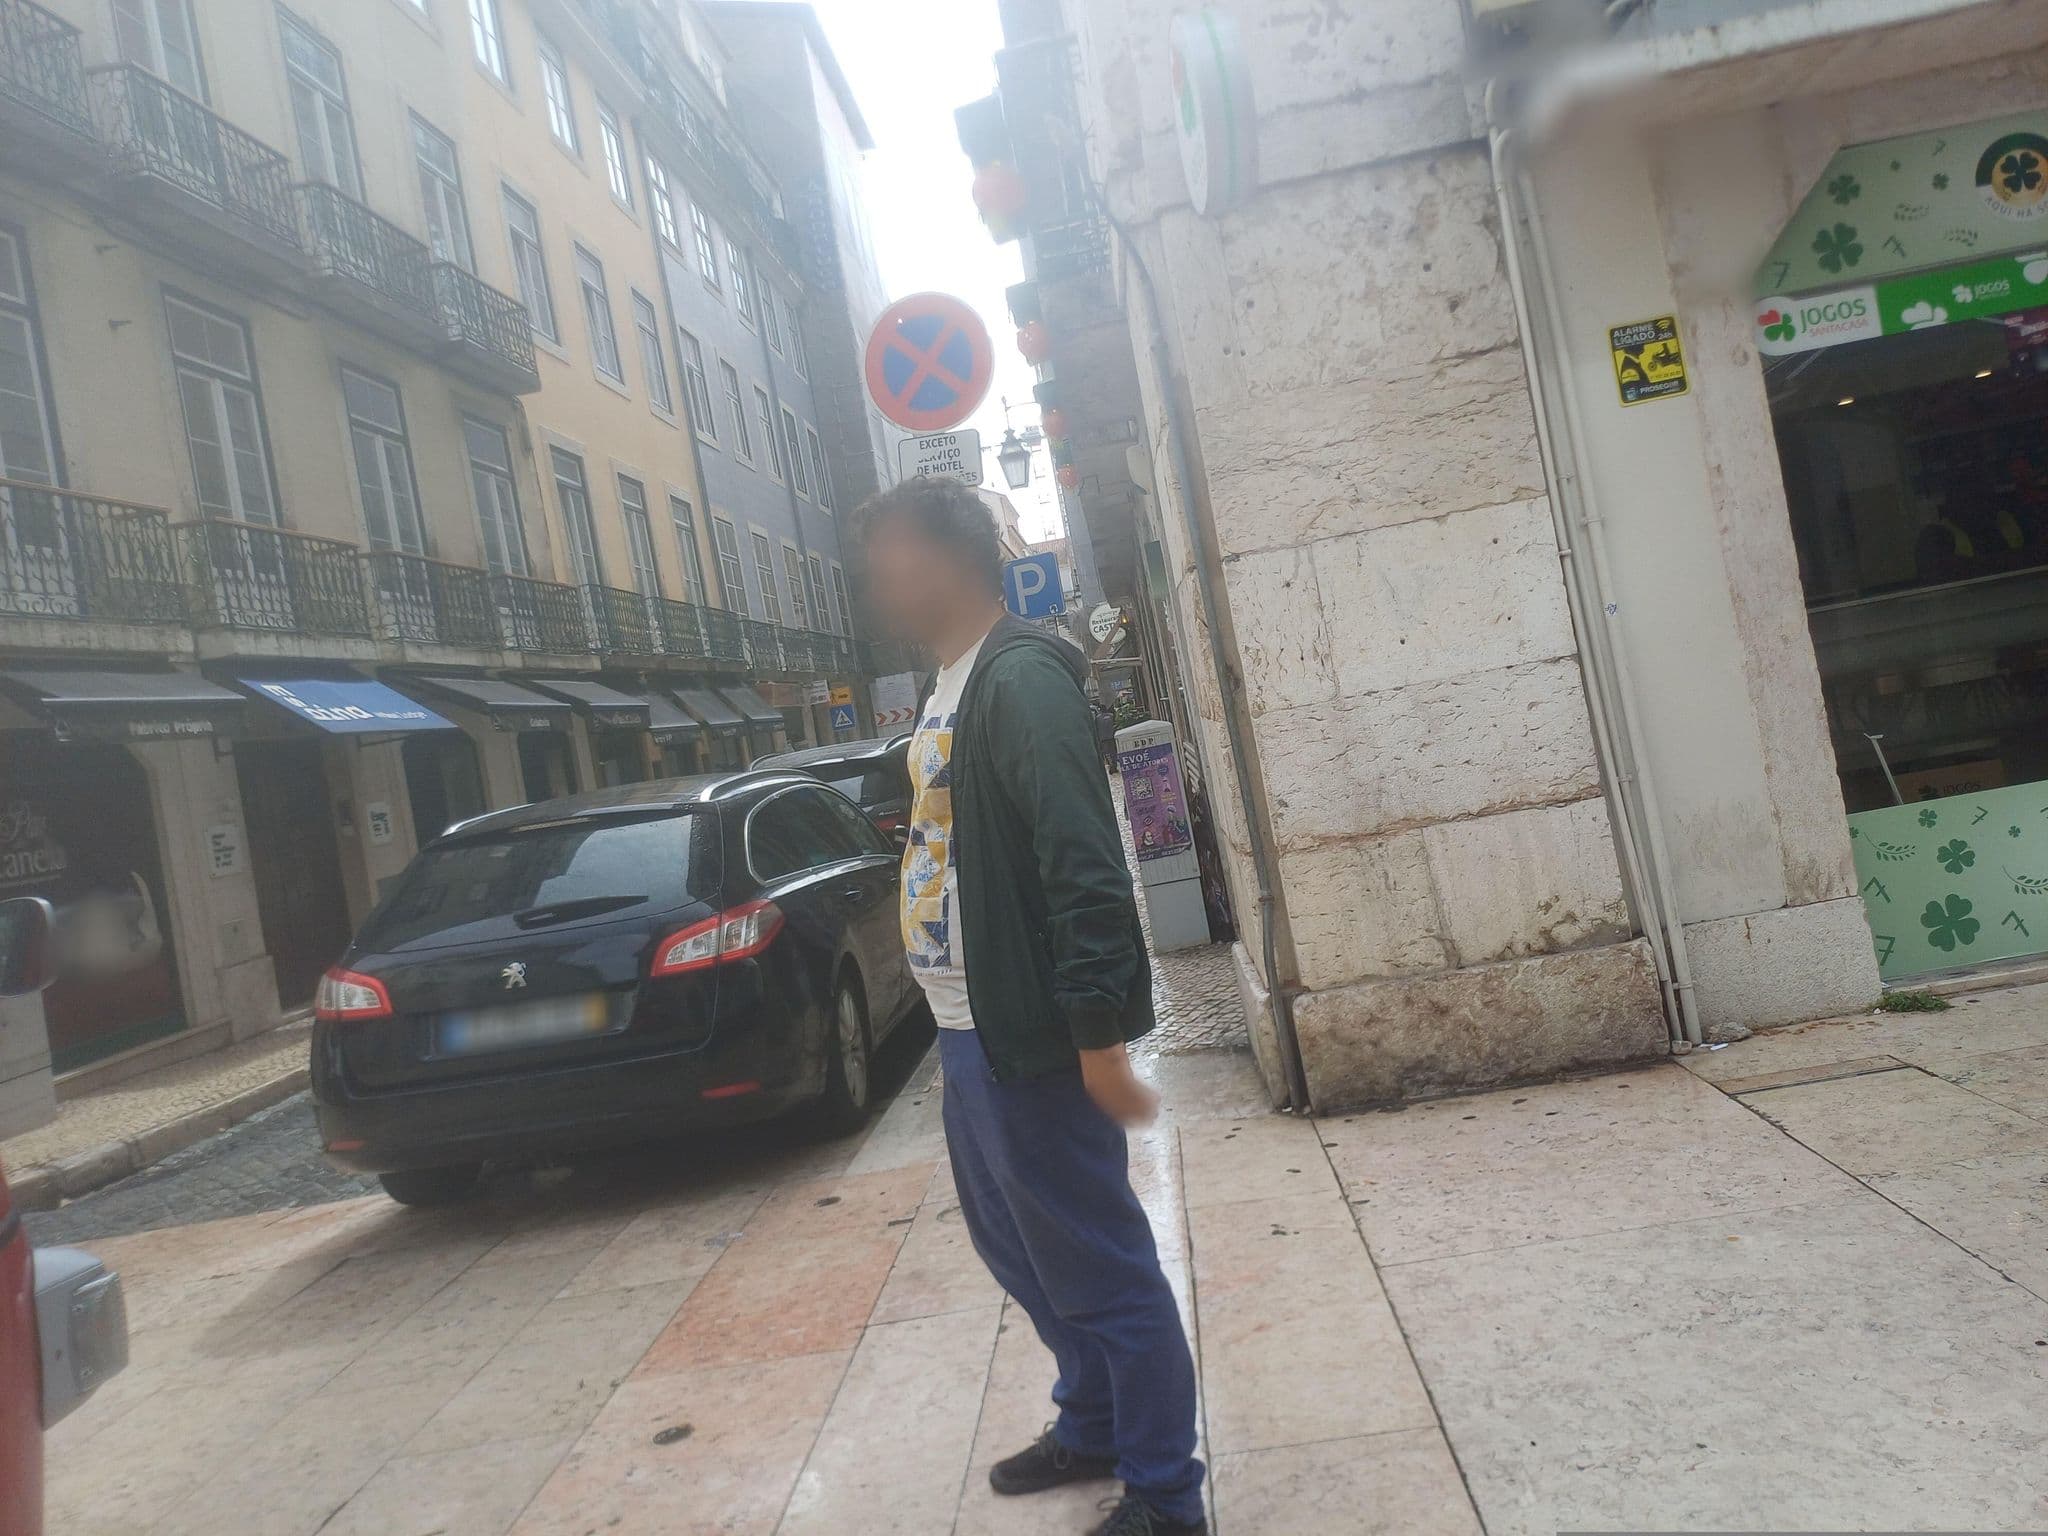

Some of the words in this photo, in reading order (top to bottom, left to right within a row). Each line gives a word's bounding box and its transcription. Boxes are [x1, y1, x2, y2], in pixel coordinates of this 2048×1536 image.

[1974, 279, 2010, 299] JOGOS
[1800, 298, 1867, 333] JOGOS
[1613, 324, 1654, 338] ALARME
[1809, 319, 1869, 337] SANTACASA
[1614, 330, 1656, 346] LIGADO
[919, 435, 957, 450] EXCETO
[916, 464, 930, 475] DE
[932, 460, 965, 473] HOTEL
[1012, 562, 1046, 615] P
[1134, 738, 1154, 748] EDP
[1122, 750, 1150, 765] EVOÉ
